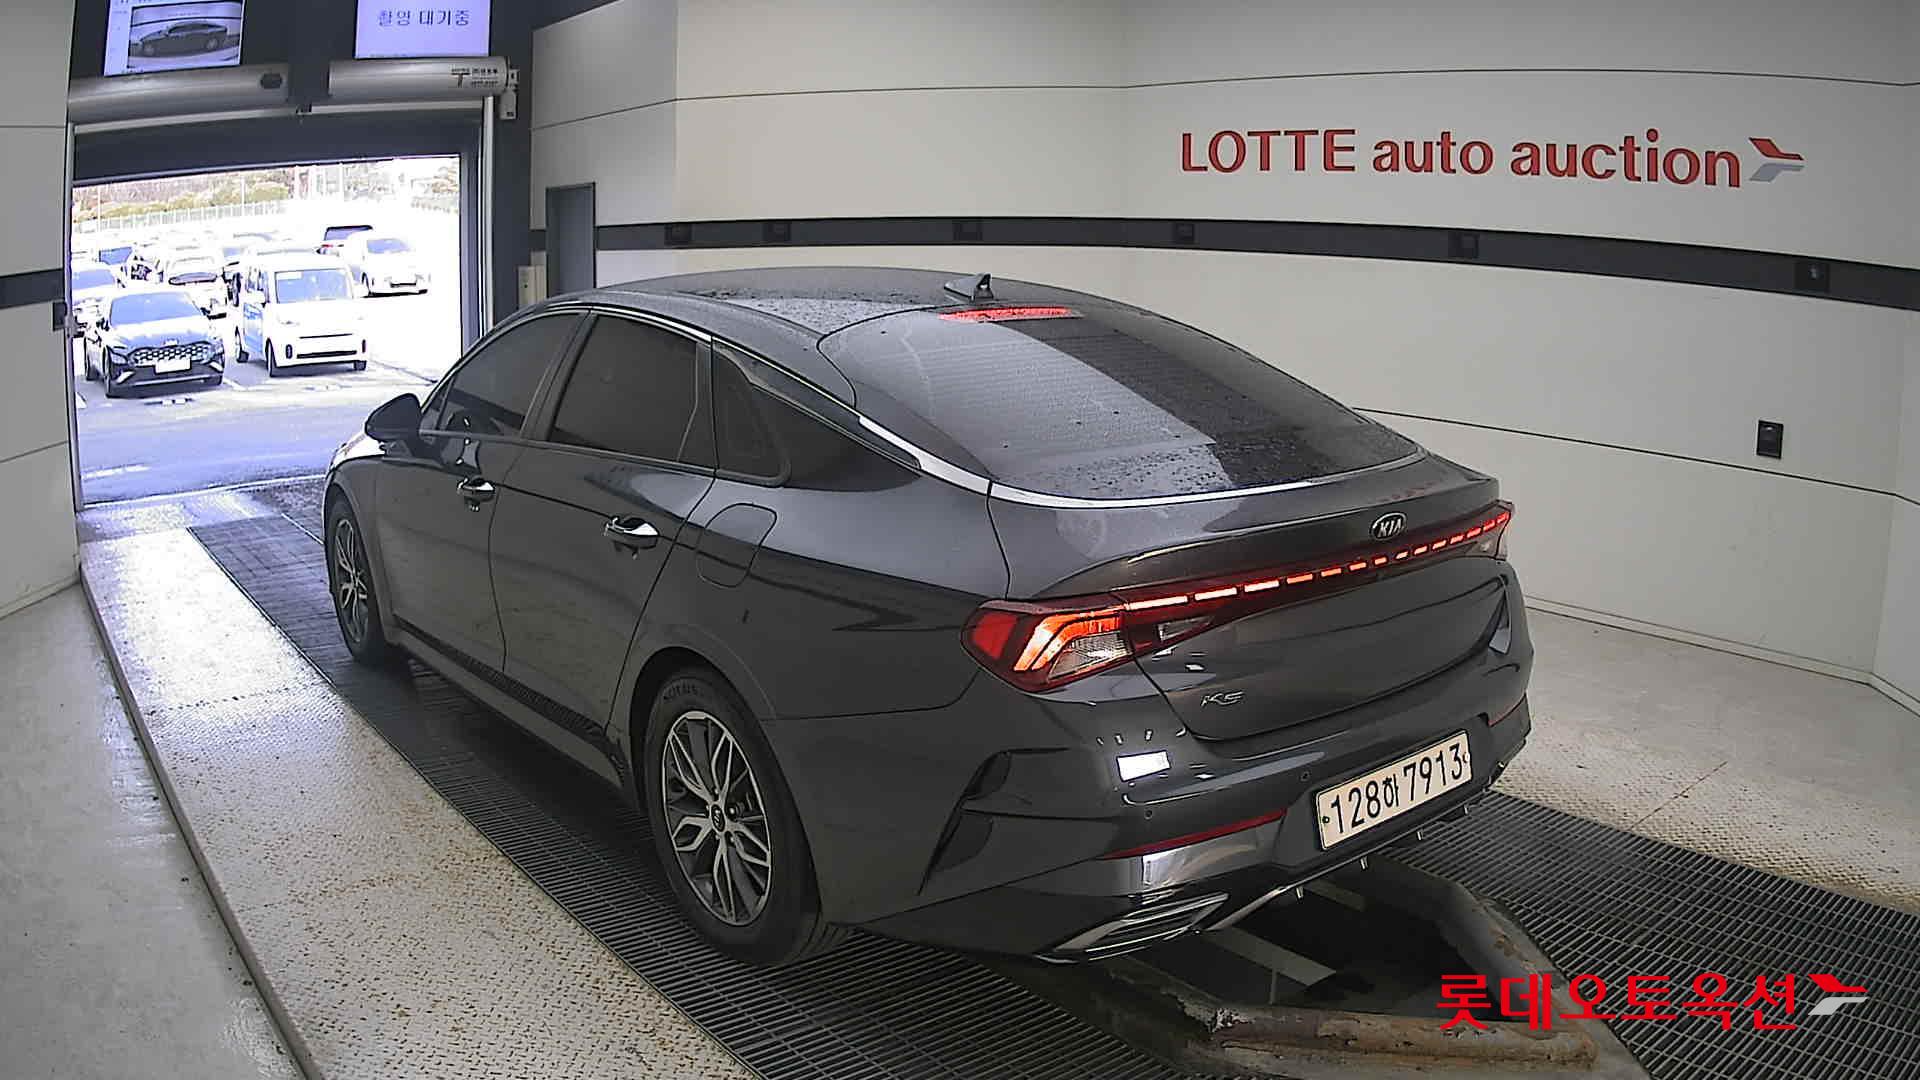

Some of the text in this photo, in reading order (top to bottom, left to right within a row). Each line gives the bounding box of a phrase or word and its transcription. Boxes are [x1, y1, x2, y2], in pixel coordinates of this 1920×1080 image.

[418, 9, 470, 26] 대기중
[1182, 128, 1742, 188] LOTTE auto auction
[1378, 518, 1404, 538] KIA
[1200, 691, 1244, 707] K5
[1330, 742, 1463, 834] 128하 7913
